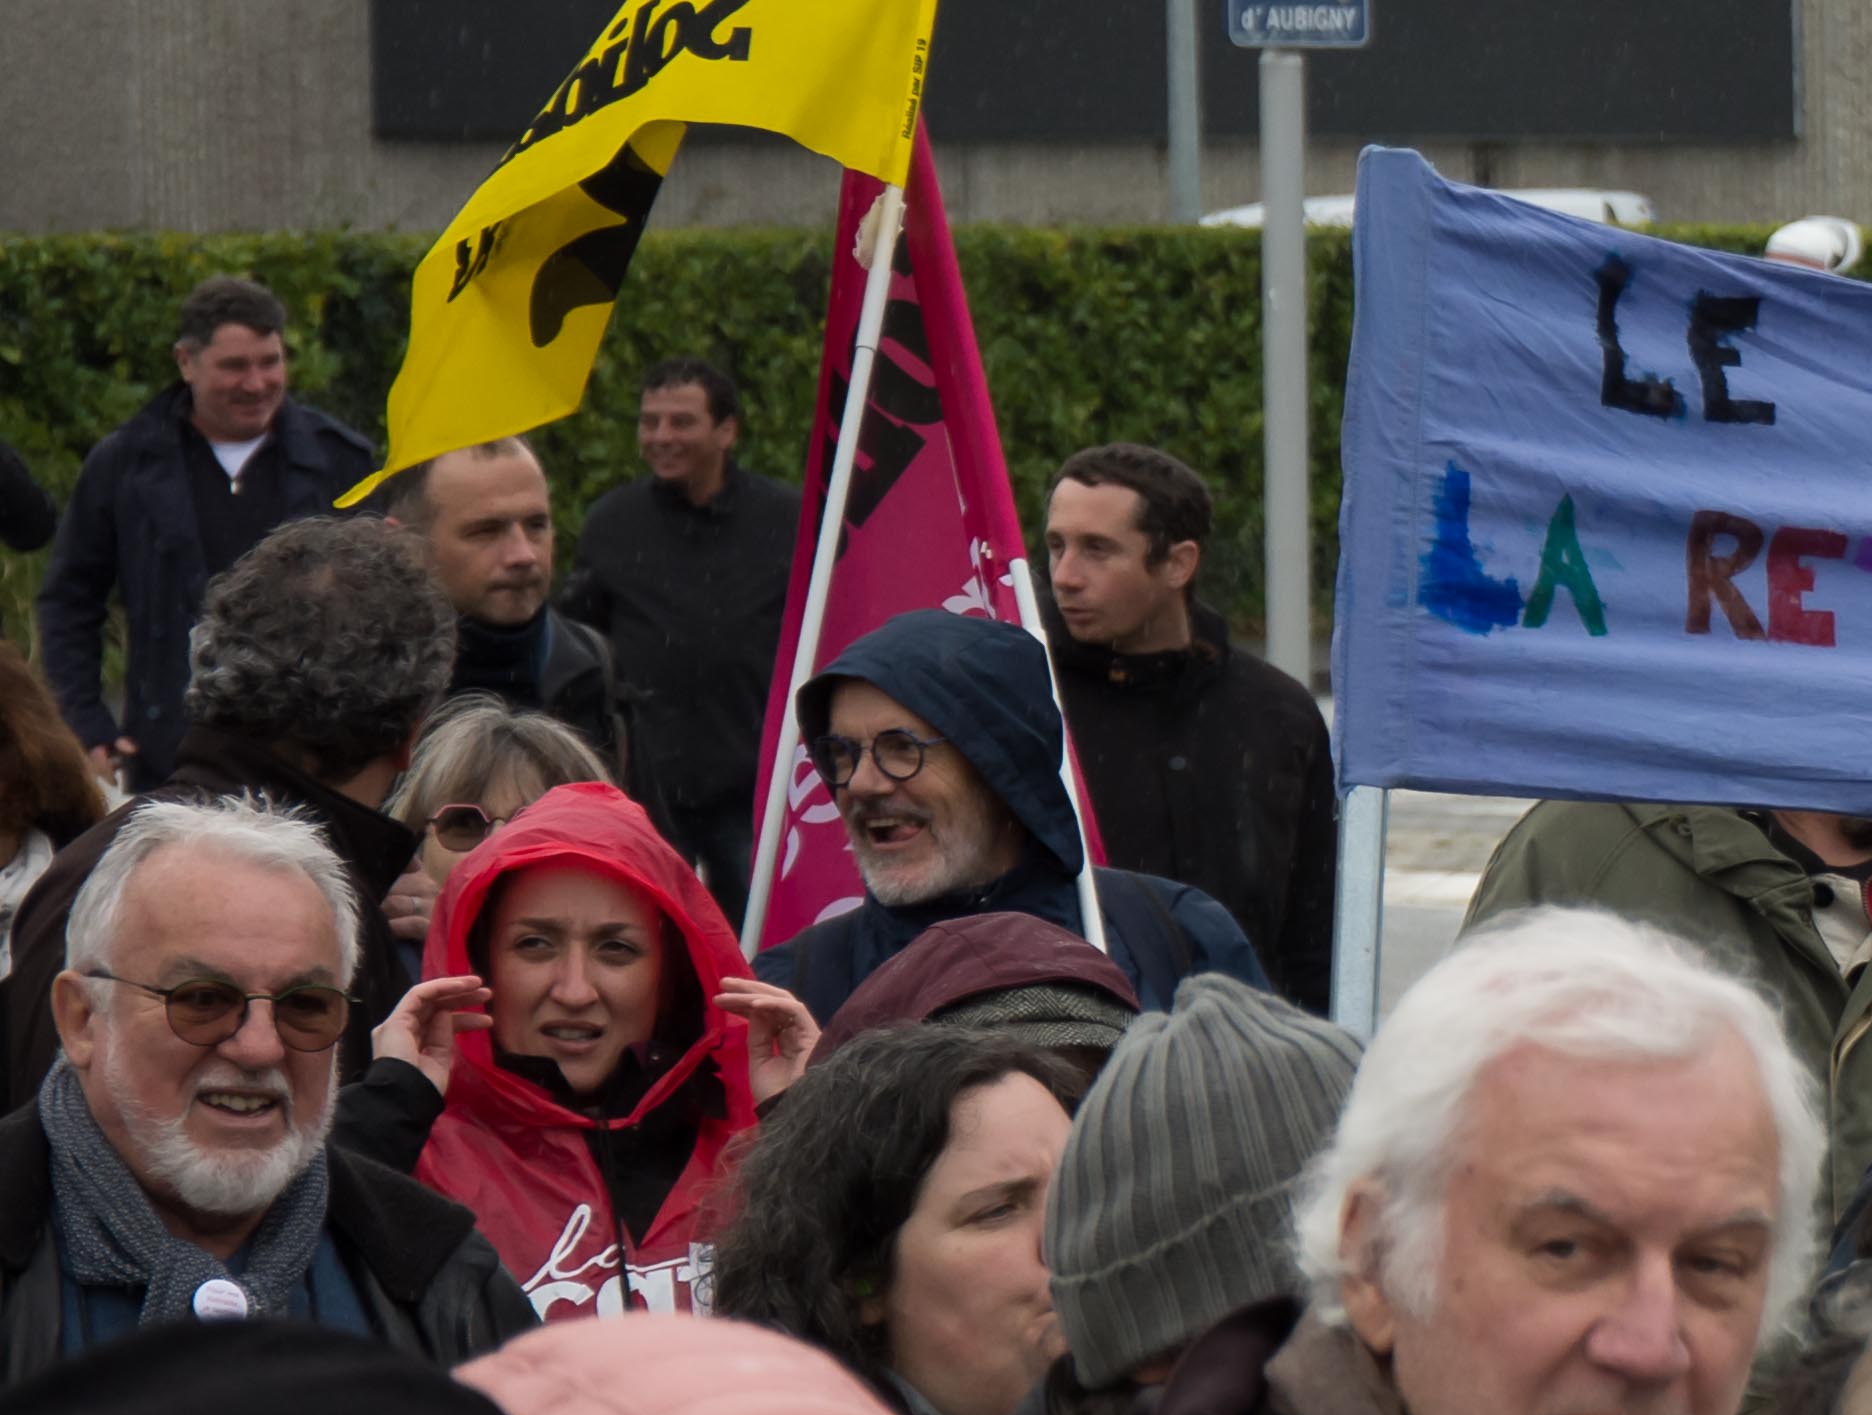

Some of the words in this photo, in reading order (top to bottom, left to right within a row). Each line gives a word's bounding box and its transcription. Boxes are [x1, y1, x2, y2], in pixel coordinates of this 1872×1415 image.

[912, 77, 921, 96] par
[1594, 252, 1778, 424] LE
[1418, 460, 1608, 638] LA
